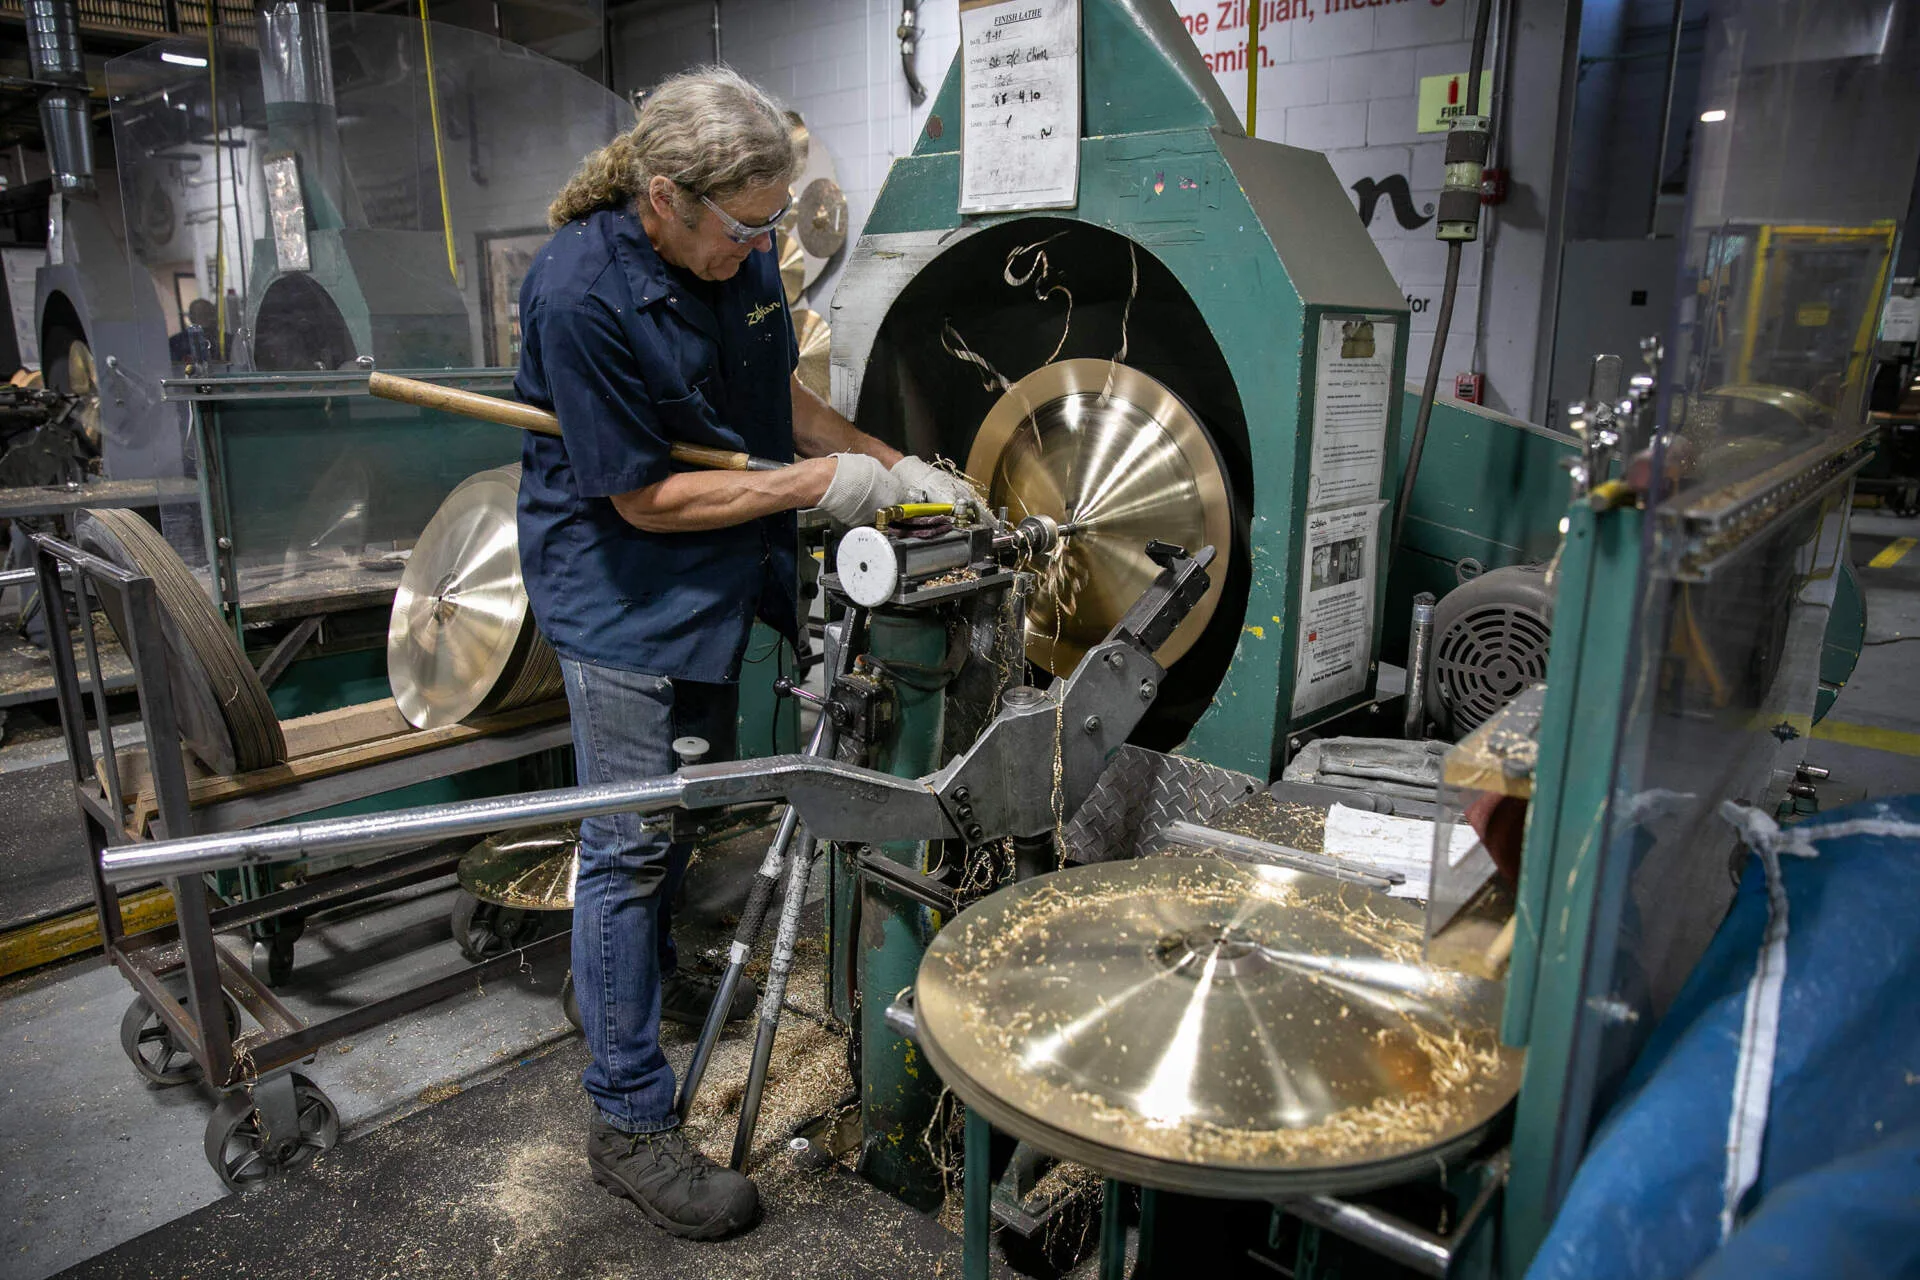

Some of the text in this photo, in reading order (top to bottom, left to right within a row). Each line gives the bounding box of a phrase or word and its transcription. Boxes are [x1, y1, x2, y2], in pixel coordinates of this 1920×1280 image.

[994, 8, 1042, 26] FINISH LATHE
[1216, 0, 1315, 31] Ziljian,
[1441, 105, 1465, 118] FIRE
[1407, 294, 1431, 312] for
